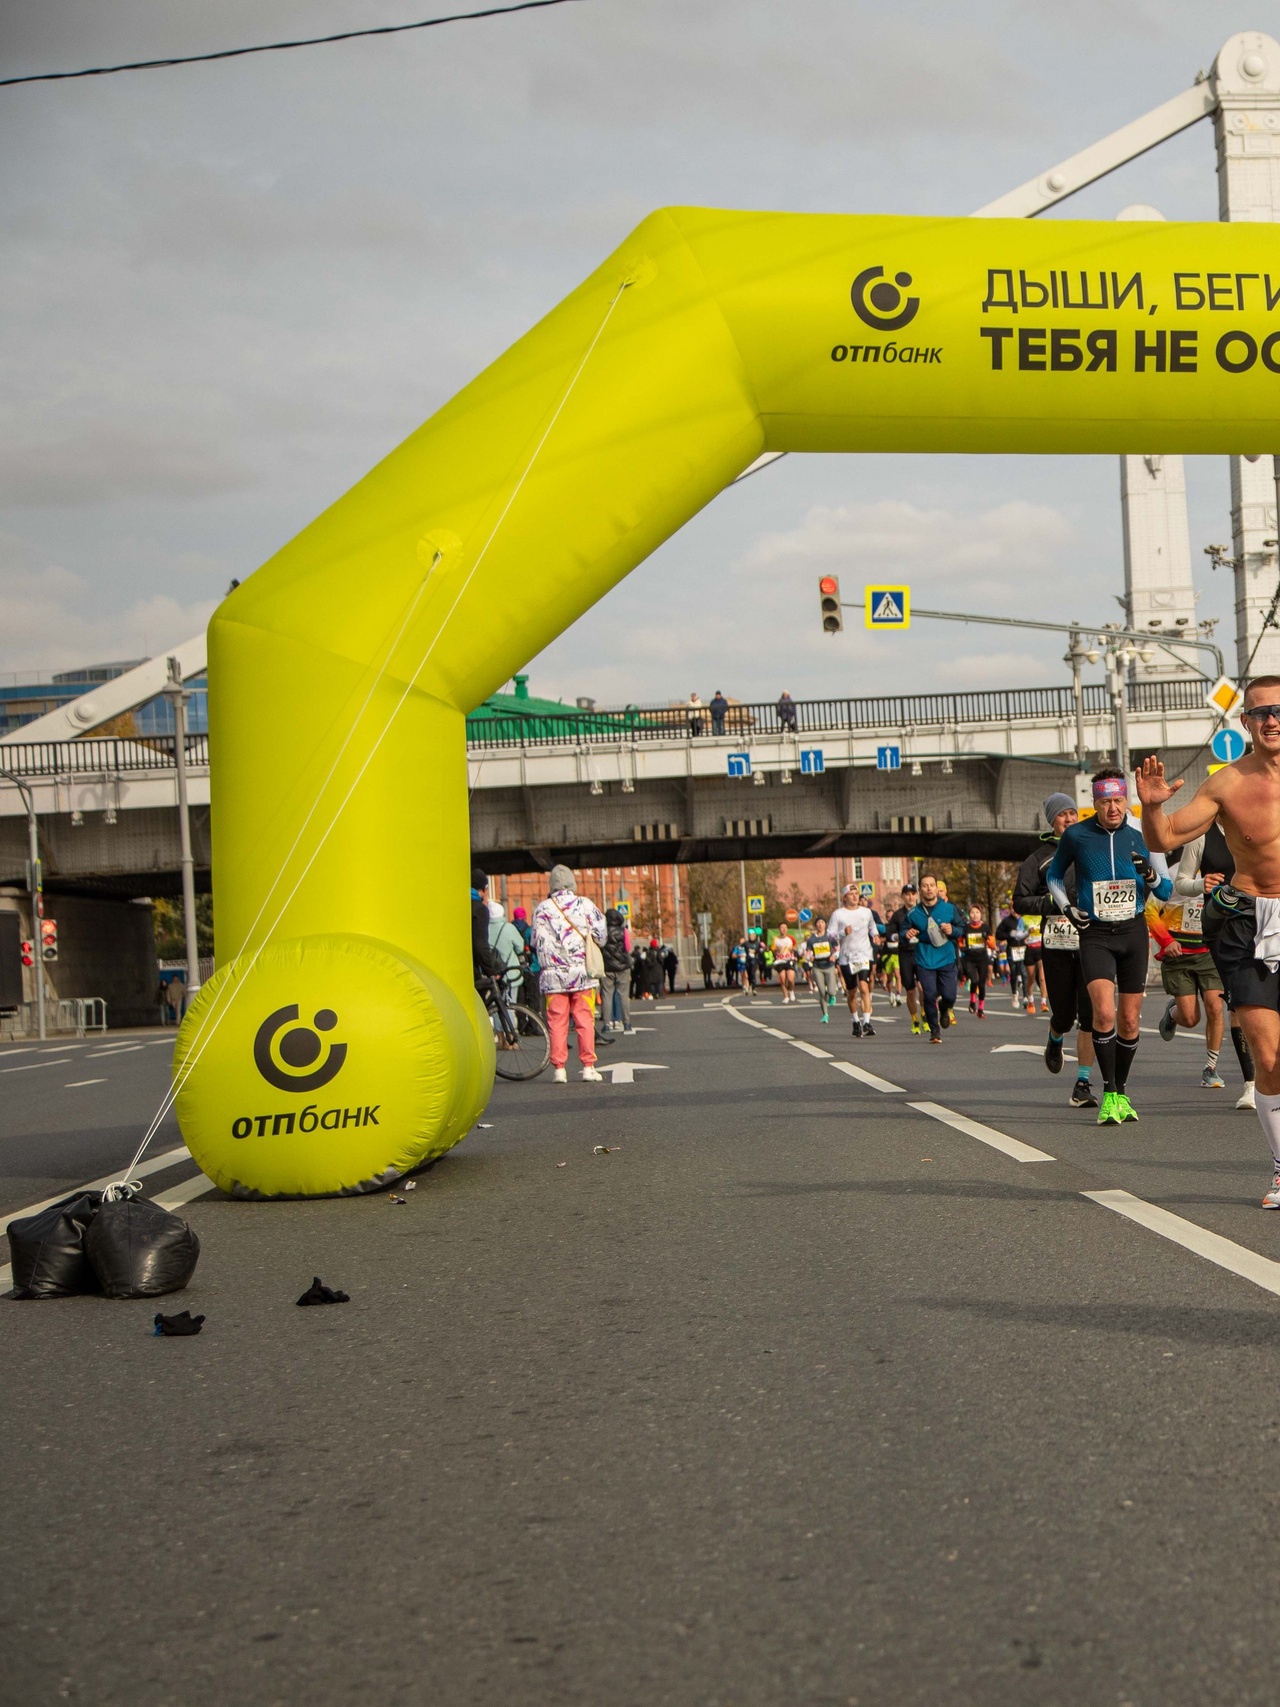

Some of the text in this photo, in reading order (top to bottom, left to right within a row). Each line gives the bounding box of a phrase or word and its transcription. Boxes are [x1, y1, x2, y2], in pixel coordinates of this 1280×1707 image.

[982, 269, 1158, 315] ДЫШИ,
[980, 326, 1117, 373] ТЕБЯ
[1135, 329, 1198, 373] НЕ
[1096, 890, 1135, 904] 16226
